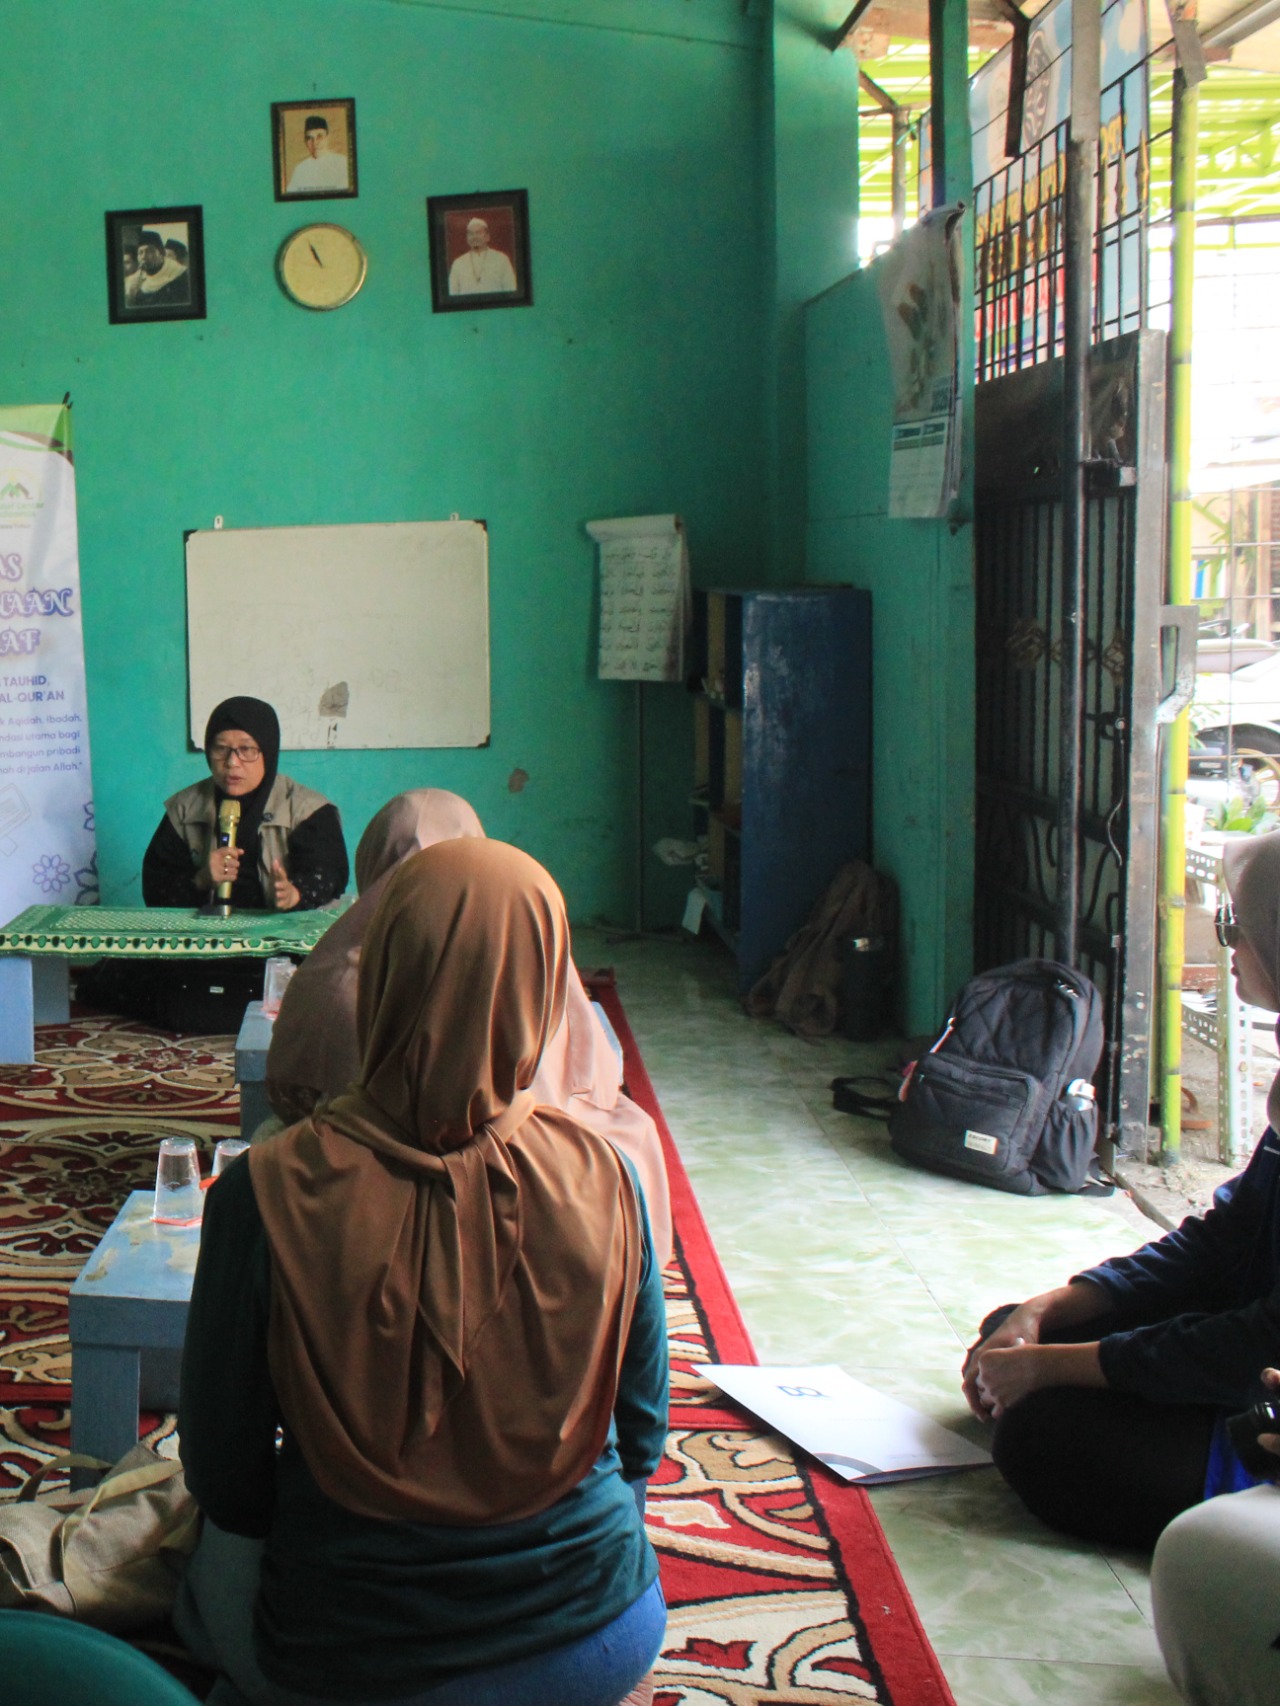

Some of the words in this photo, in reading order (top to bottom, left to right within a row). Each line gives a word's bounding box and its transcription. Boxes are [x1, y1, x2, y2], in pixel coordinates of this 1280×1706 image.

[25, 732, 56, 741] utama
[58, 730, 80, 740] bagi
[46, 745, 81, 757] pribadi
[16, 766, 25, 774] di
[27, 764, 51, 775] jalan
